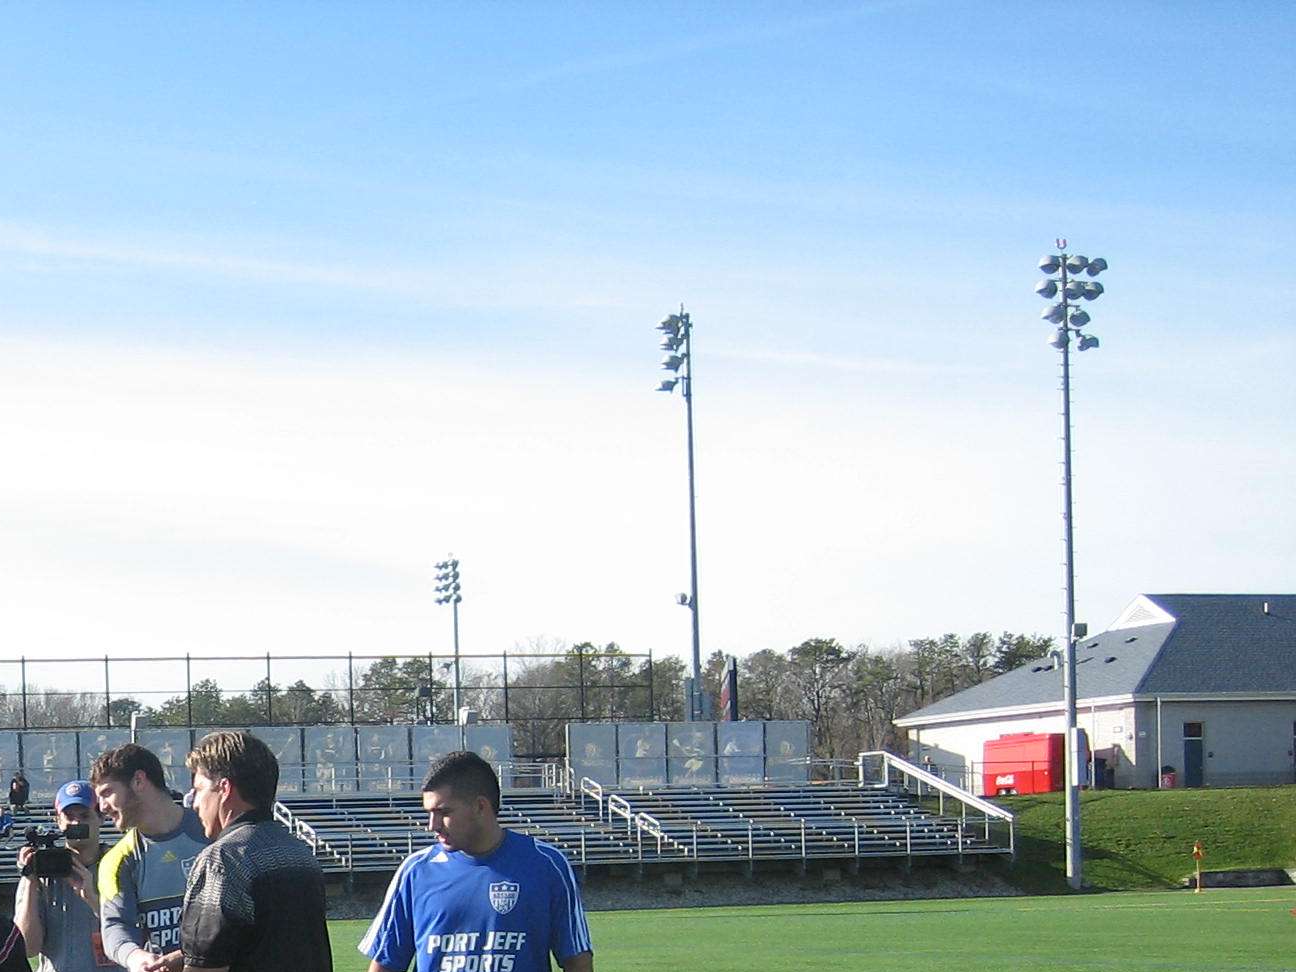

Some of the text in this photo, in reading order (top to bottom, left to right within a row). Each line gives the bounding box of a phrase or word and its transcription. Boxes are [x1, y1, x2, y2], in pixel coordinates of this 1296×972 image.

[150, 927, 181, 947] SPO
[427, 931, 526, 954] PORT JEFF
